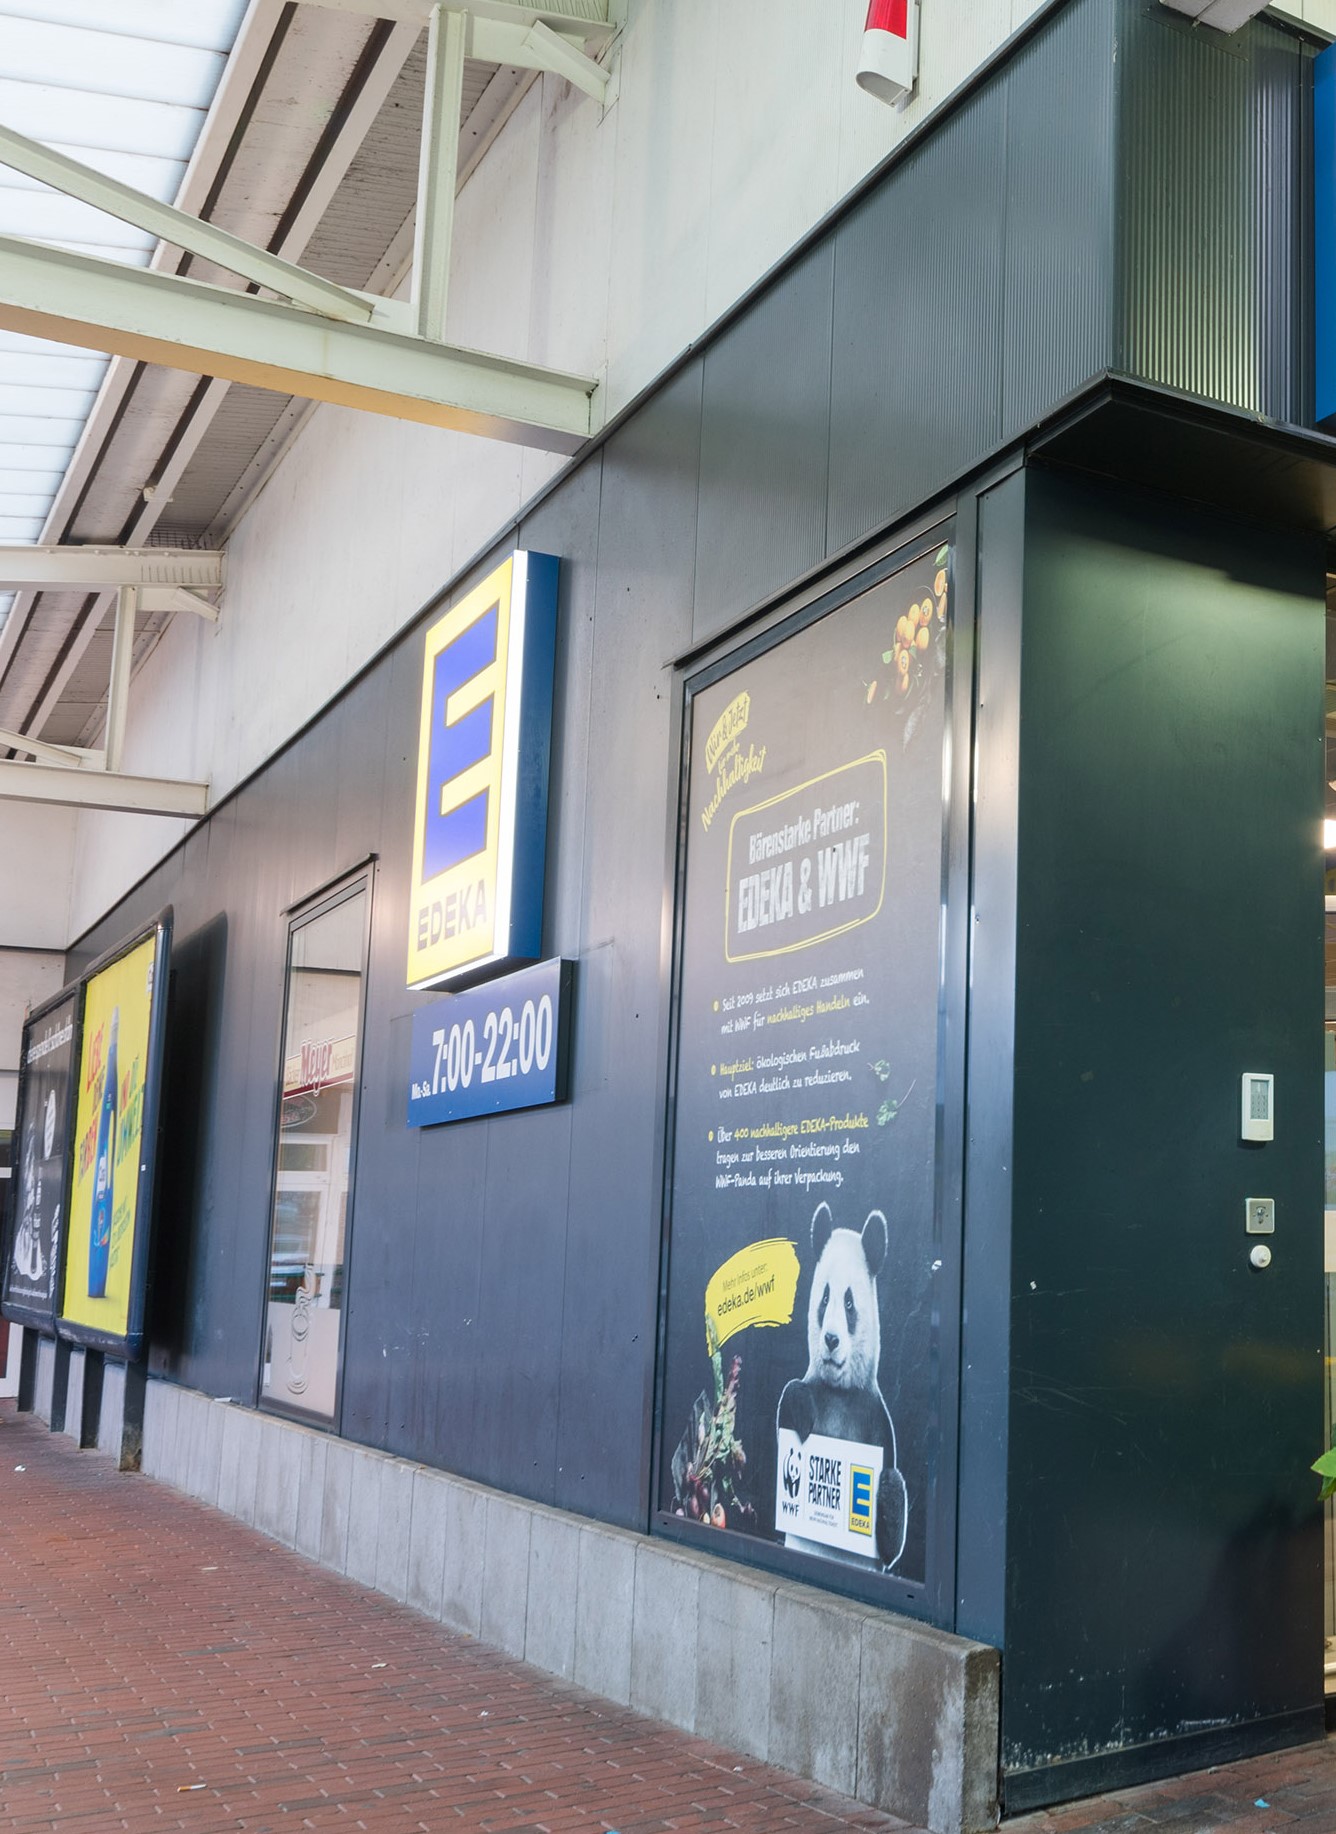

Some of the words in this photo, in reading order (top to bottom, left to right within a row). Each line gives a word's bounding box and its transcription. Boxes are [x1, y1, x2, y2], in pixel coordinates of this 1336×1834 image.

[701, 743, 767, 832] Nachhaltigkeit
[749, 815, 811, 865] Bärenstarke
[813, 800, 860, 840] Partner:
[738, 861, 793, 933] EDEKA
[798, 857, 812, 914] &
[817, 833, 870, 907] WWF
[417, 879, 487, 952] EDEKA
[722, 999, 735, 1012] Seit
[736, 993, 754, 1008] 2009
[755, 986, 773, 1003] setzt
[775, 982, 791, 999] sich
[792, 975, 818, 995] EDEKA
[820, 968, 864, 988] zusammen
[721, 1021, 733, 1035] mit
[735, 1016, 751, 1032] WWF
[753, 1011, 765, 1031] für
[767, 1004, 814, 1023] nachhaltiges
[816, 994, 850, 1014] Handeln
[852, 992, 870, 1007] ein.
[720, 1056, 754, 1081] Hauptziel:
[756, 1050, 807, 1071] ökologischen
[809, 1039, 861, 1060] Fußabdruck
[719, 1087, 732, 1099] von
[734, 1081, 757, 1097] EDEKA
[759, 1075, 791, 1093] deutlich
[792, 1078, 802, 1088] zu
[805, 1069, 852, 1087] reduzieren.
[717, 1126, 732, 1143] Über
[734, 1128, 749, 1141] 400
[750, 1121, 799, 1141] nachhaltigere
[800, 1112, 869, 1134] EDEKA-Produkte
[716, 1150, 739, 1169] tragen
[741, 1152, 754, 1162] zur
[756, 1145, 787, 1162] besseren
[790, 1141, 840, 1161] Orientierung
[843, 1138, 860, 1154] den
[716, 1172, 756, 1189] WWF-Panda
[759, 1168, 773, 1189] auf
[774, 1170, 792, 1185] ihrer
[794, 1168, 844, 1191] Verpackung.
[717, 1274, 776, 1316] edeka.de/wwf
[808, 1455, 842, 1486] STARKE
[782, 1501, 800, 1517] WWF
[808, 1483, 841, 1511] PARTNER
[851, 1517, 870, 1529] EDEKA
